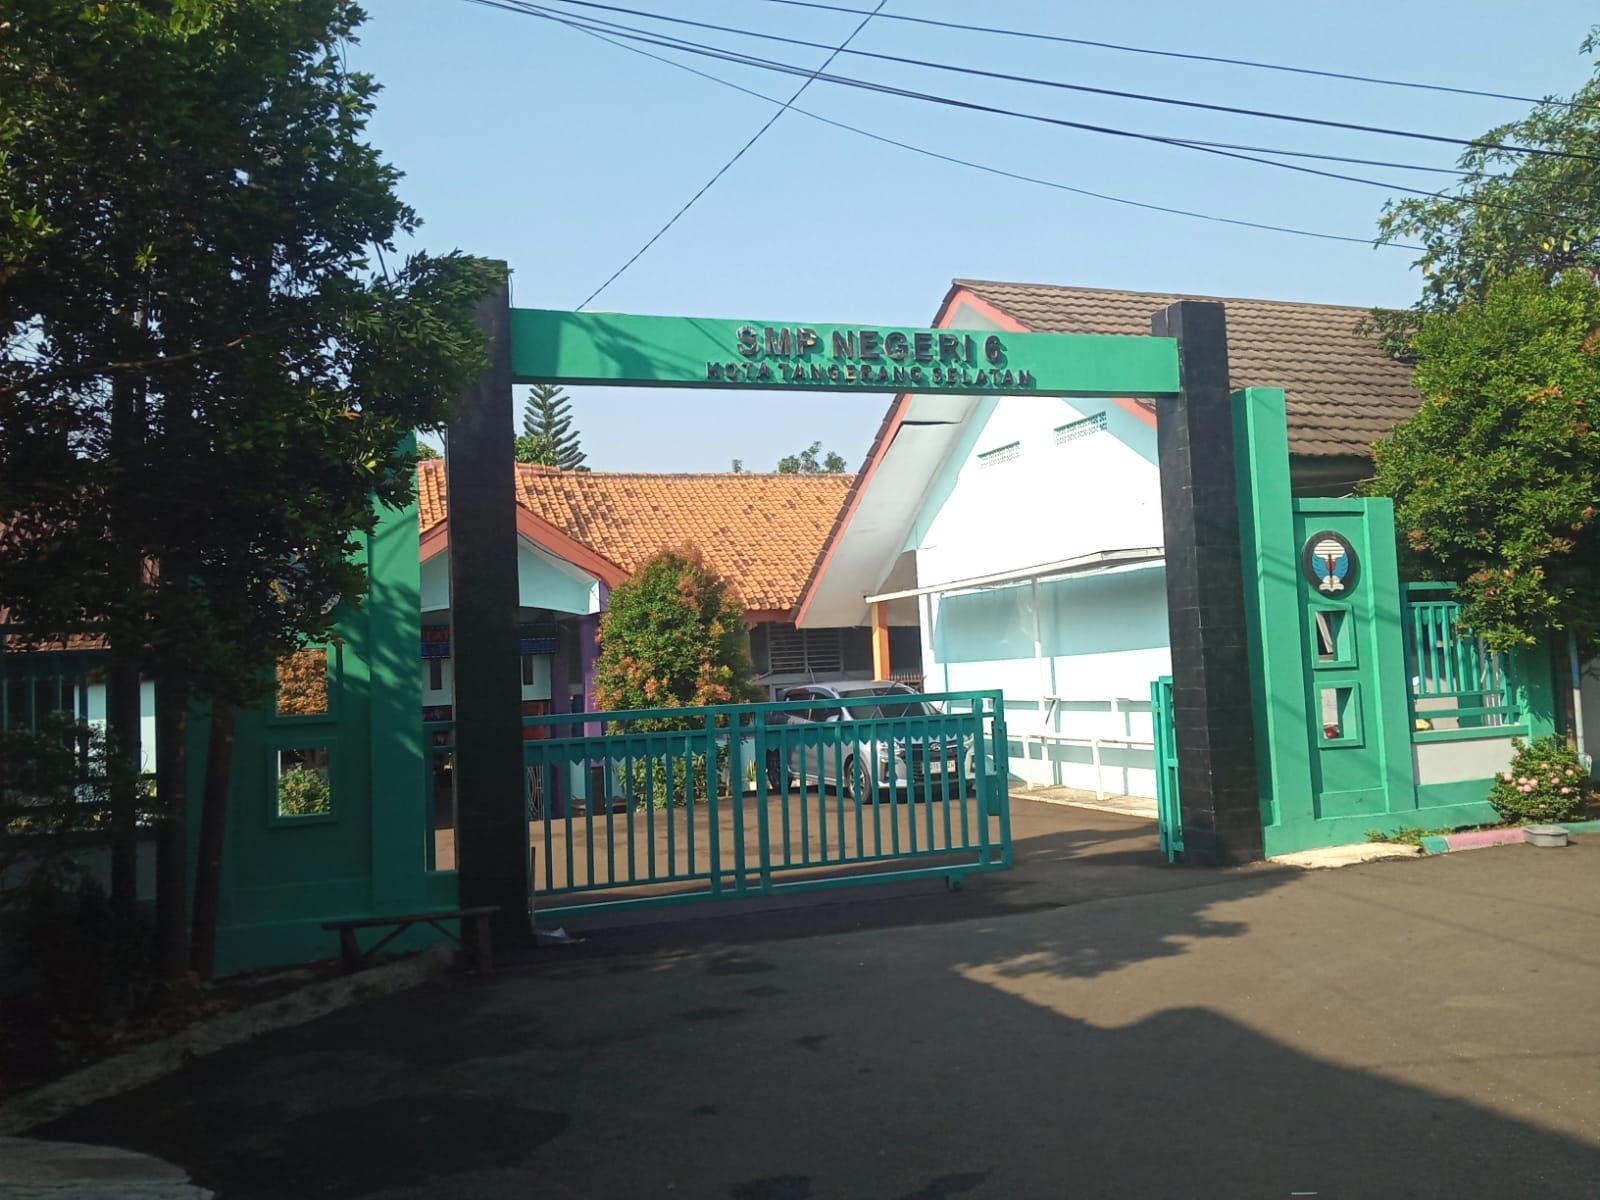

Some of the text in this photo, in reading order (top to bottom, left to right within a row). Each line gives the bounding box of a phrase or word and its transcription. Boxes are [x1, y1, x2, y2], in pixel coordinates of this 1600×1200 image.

[736, 325, 1001, 364] SMP NEGERI 6
[706, 362, 1030, 385] KOTA TANGERANG SELATAN
